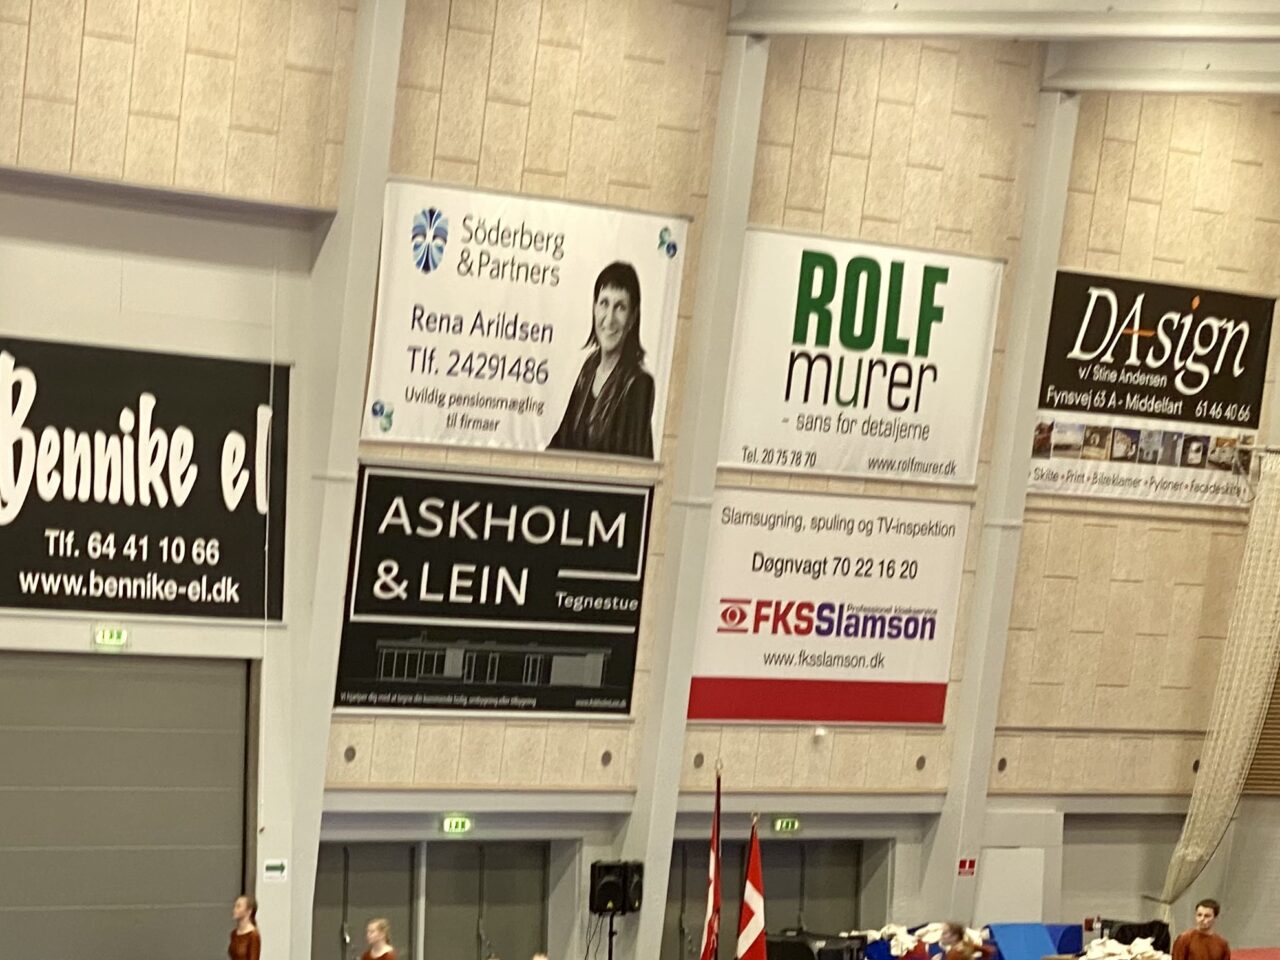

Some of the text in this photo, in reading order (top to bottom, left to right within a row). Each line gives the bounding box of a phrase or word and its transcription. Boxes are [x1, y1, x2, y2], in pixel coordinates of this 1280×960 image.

[460, 213, 565, 261] Söderberg
[456, 247, 560, 287] & Partners
[792, 249, 950, 358] ROLF
[411, 303, 554, 345] Rena Arildsen
[1066, 285, 1251, 396] DAsign
[406, 345, 550, 386] Tlf. 24291486
[784, 349, 938, 414] murer
[1078, 363, 1168, 388] v/ Stine Andersen
[405, 386, 545, 417] Uvildig pensionsmægling
[1046, 384, 1183, 415] Fynsvej 63 A Middelfart
[1195, 400, 1251, 422] 61 46 40 66
[446, 412, 501, 432] til firmaer
[796, 412, 831, 434] sans
[836, 410, 858, 435] for
[861, 413, 930, 443] detaljerne
[220, 403, 273, 515] el
[742, 445, 817, 468] Tel. 20 75 78 70
[867, 455, 957, 477] www.rolfmurer.dk
[1065, 468, 1086, 485] Print
[377, 495, 627, 549] ASKHOLM
[721, 506, 956, 539] Slamsugning, spuling og TV-inspektion
[44, 528, 220, 567] Tlf. 64 41 10 66
[372, 558, 529, 606] & LEIN
[751, 551, 918, 580] Døgnvagt 70 22 16 20
[18, 569, 240, 604] www.bennike-el.dk
[555, 590, 639, 612] Tegnestue
[763, 649, 886, 669] www.fksslamson.dk
